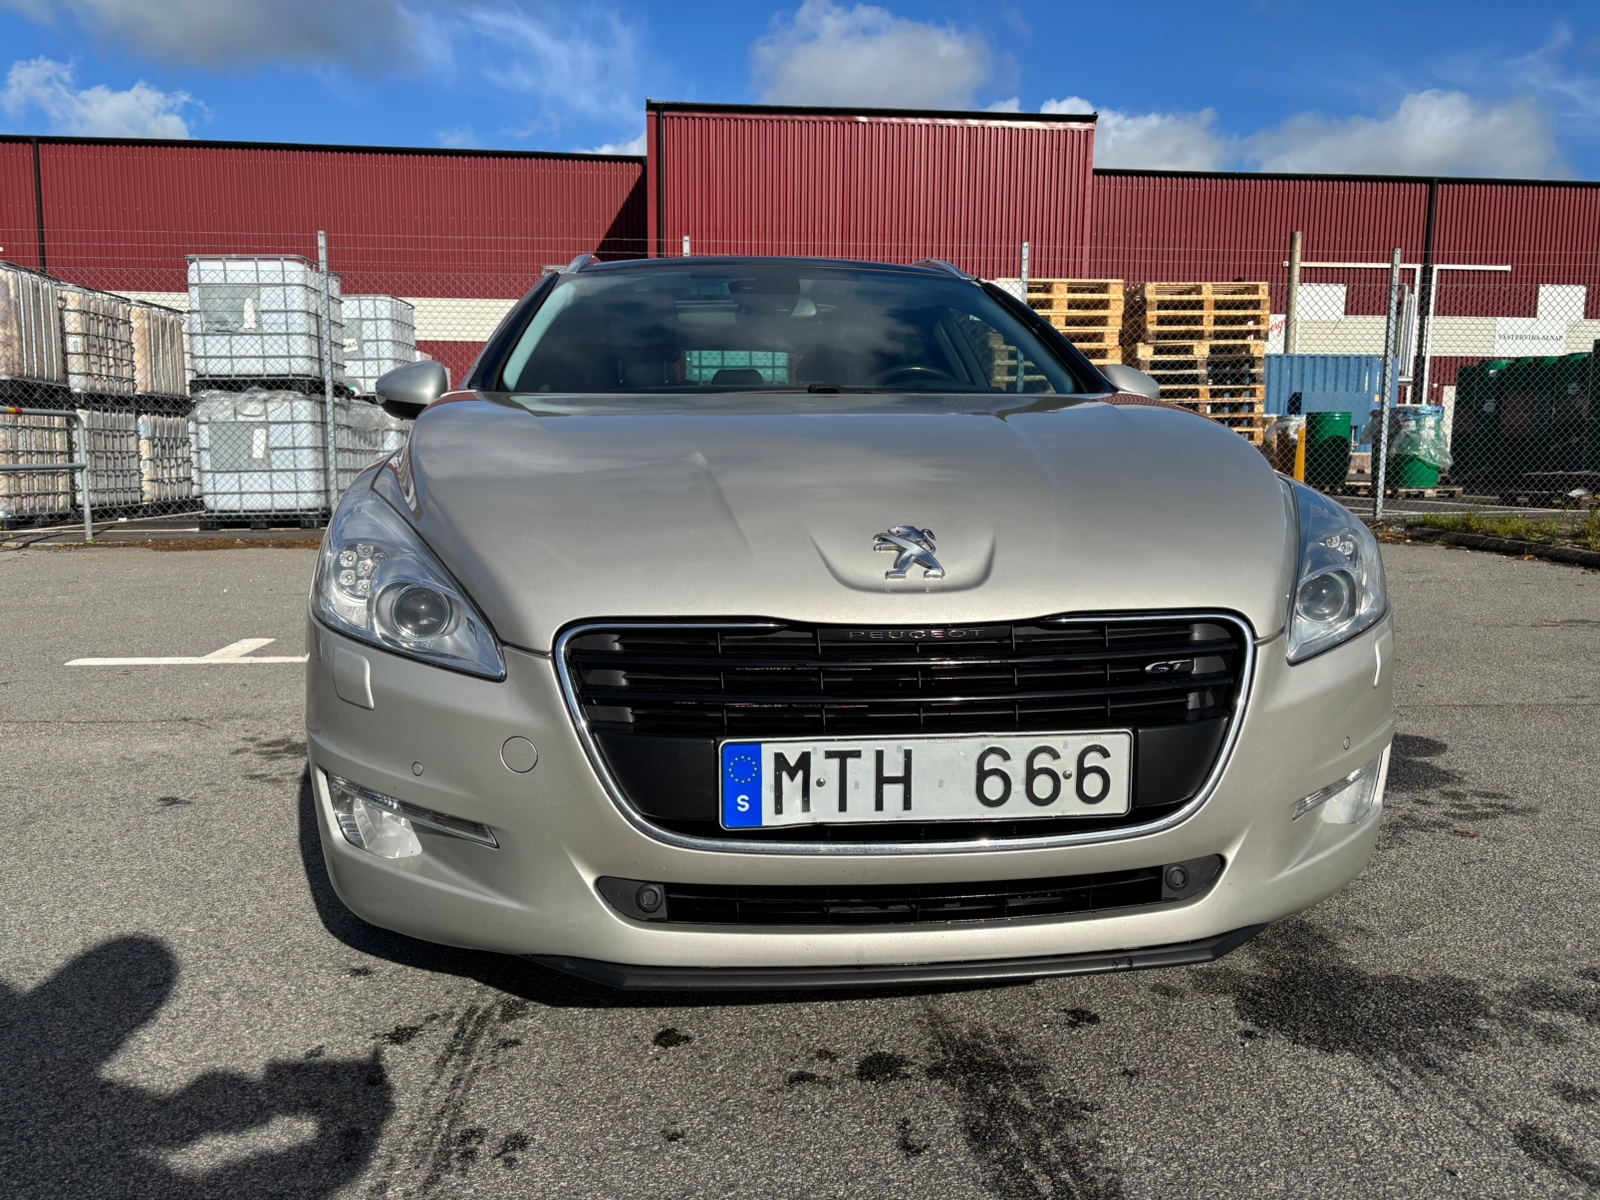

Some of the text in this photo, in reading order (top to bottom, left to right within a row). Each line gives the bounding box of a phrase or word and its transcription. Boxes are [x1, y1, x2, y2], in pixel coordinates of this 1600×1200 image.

[849, 629, 984, 639] PEUGEOT
[1145, 660, 1191, 673] GT
[773, 744, 1111, 814] MTH 666
[736, 795, 750, 812] S
